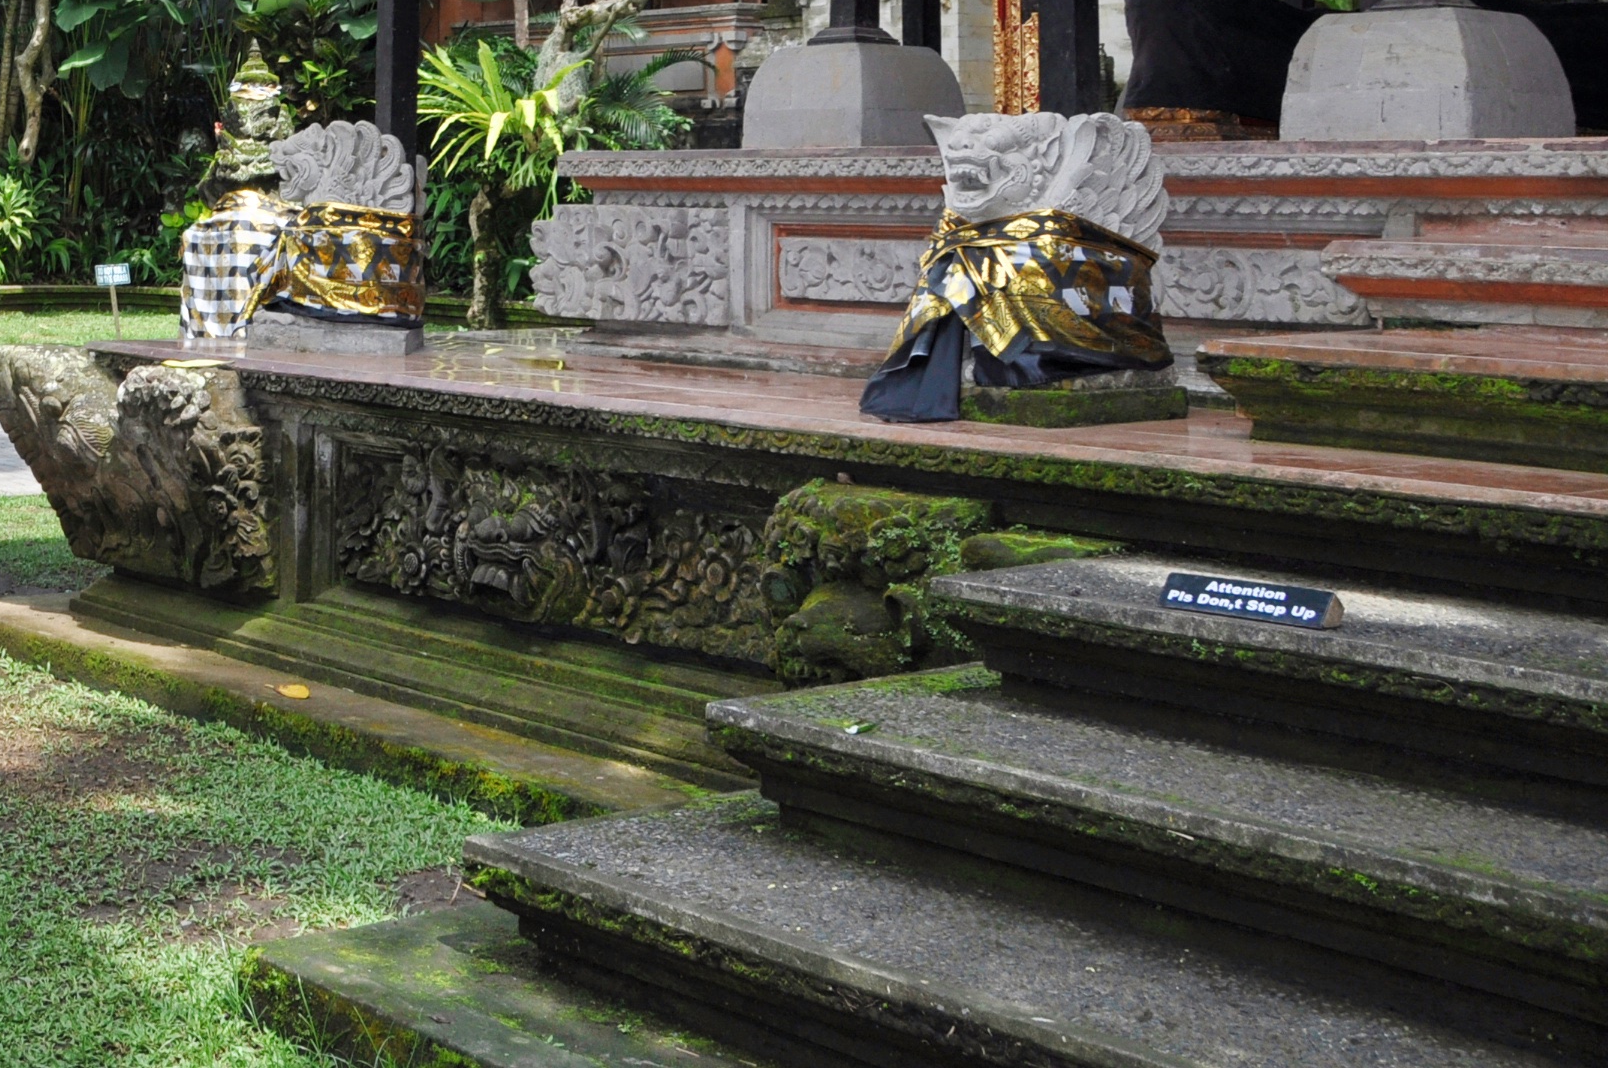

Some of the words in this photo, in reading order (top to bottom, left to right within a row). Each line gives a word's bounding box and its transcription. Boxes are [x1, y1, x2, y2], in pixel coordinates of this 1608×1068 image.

[1205, 580, 1286, 600] Attention
[1167, 589, 1193, 603] Pls
[1245, 600, 1287, 616] Step
[1291, 605, 1316, 620] Up
